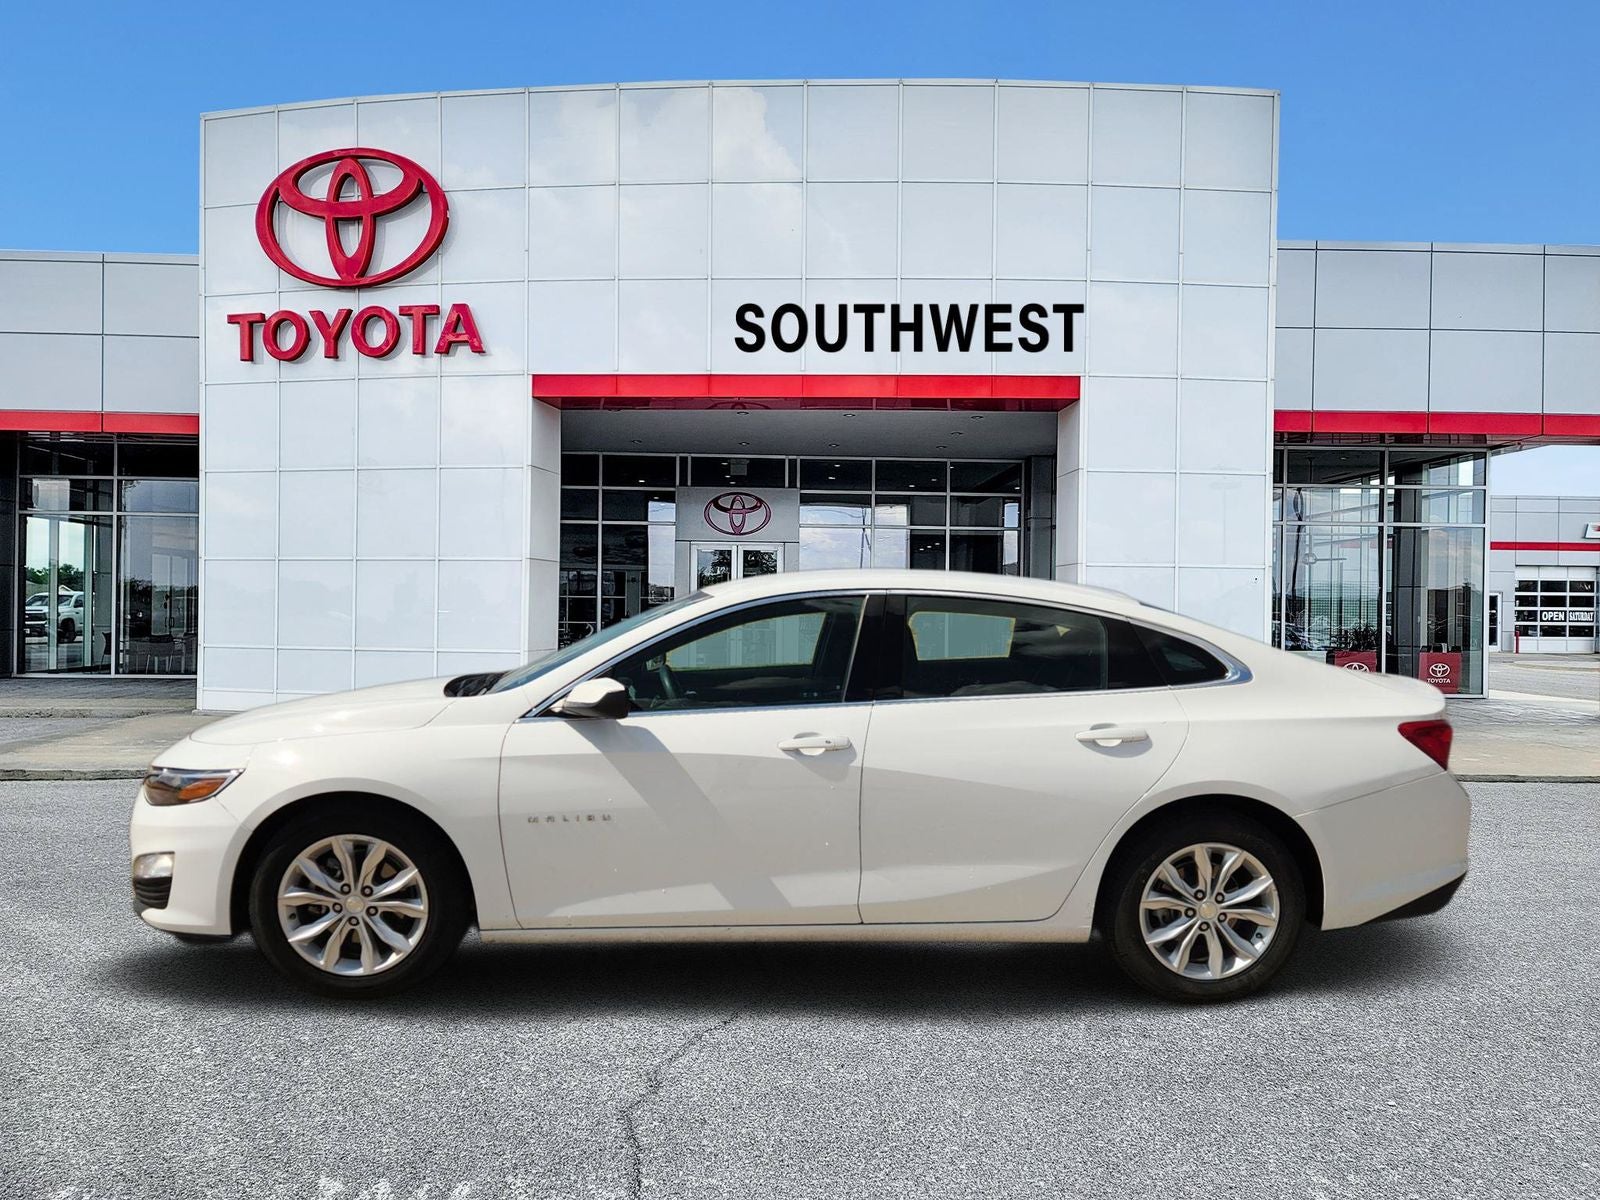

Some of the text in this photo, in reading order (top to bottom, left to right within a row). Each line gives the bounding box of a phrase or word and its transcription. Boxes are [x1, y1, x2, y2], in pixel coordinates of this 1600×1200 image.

[227, 303, 486, 362] TOYOTA
[734, 303, 1085, 353] SOUTHWEST
[1542, 611, 1594, 621] OPEN SATURDAY
[527, 814, 612, 823] MALIBU
